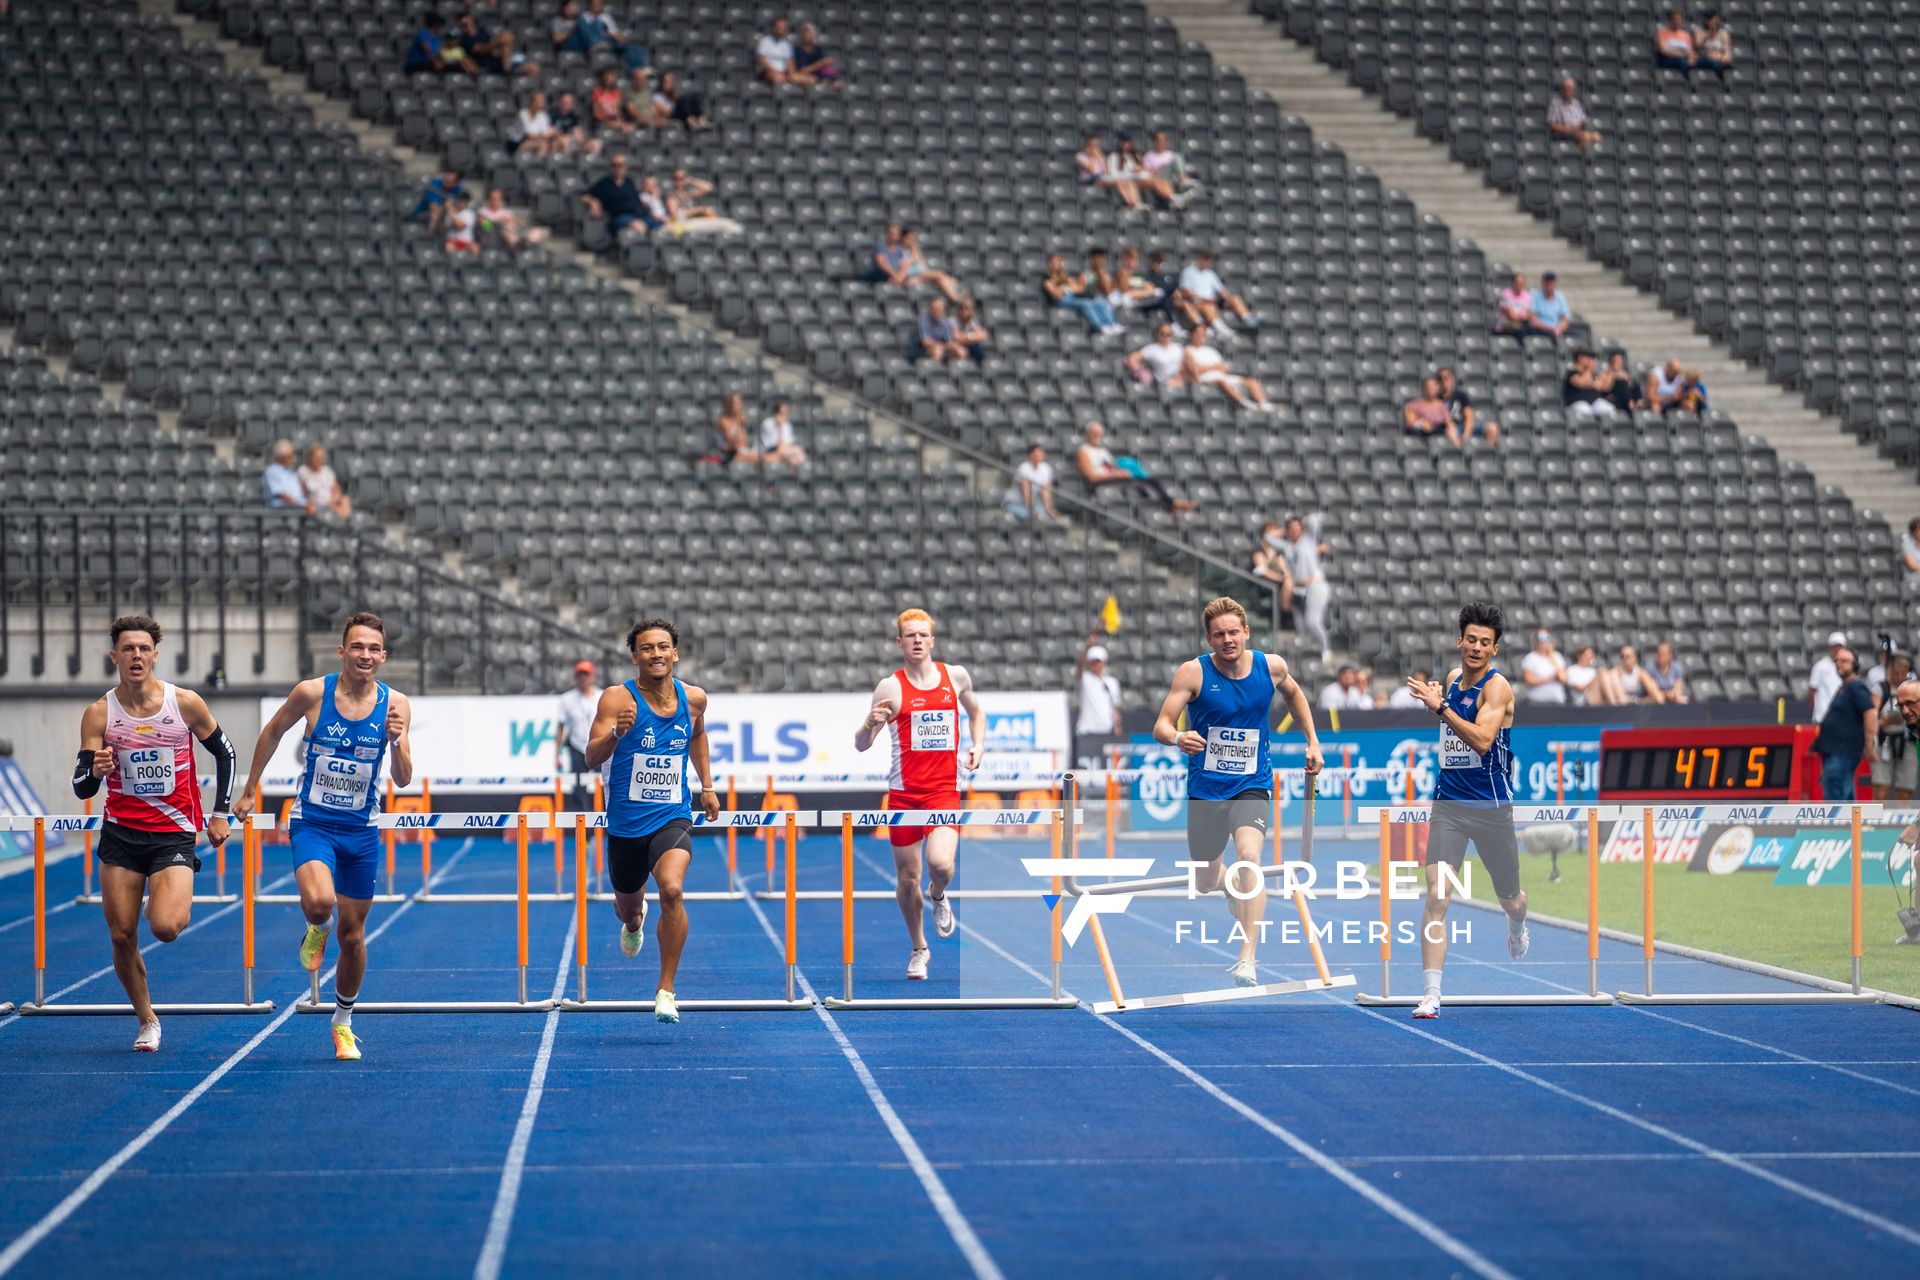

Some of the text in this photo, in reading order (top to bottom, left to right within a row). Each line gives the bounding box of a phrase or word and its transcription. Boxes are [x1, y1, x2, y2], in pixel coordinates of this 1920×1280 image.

[921, 712, 943, 722] GLS
[918, 725, 949, 736] GWIZDEK
[1220, 730, 1245, 742] GLS
[1210, 743, 1256, 758] SCHITTENHELM
[130, 750, 158, 763] GLS
[328, 760, 356, 775] GLS
[646, 758, 671, 768] GLS
[1675, 747, 1768, 789] 47.5
[124, 765, 172, 780] L. ROOS
[316, 772, 367, 793] LEWANDOWSKI
[636, 772, 679, 785] GORDON
[335, 796, 352, 804] PLAN
[995, 813, 1025, 824] ANA
[1398, 811, 1428, 822] ANA
[1534, 810, 1564, 820] ANA
[1658, 808, 1689, 819] ANA
[1728, 808, 1758, 818] ANA
[1796, 808, 1826, 818] ANA
[52, 818, 82, 830] ANA
[395, 816, 426, 827] ANA
[464, 816, 494, 826] ANA
[731, 814, 760, 826] ANA
[858, 814, 888, 824] ANA
[926, 814, 956, 824] ANA
